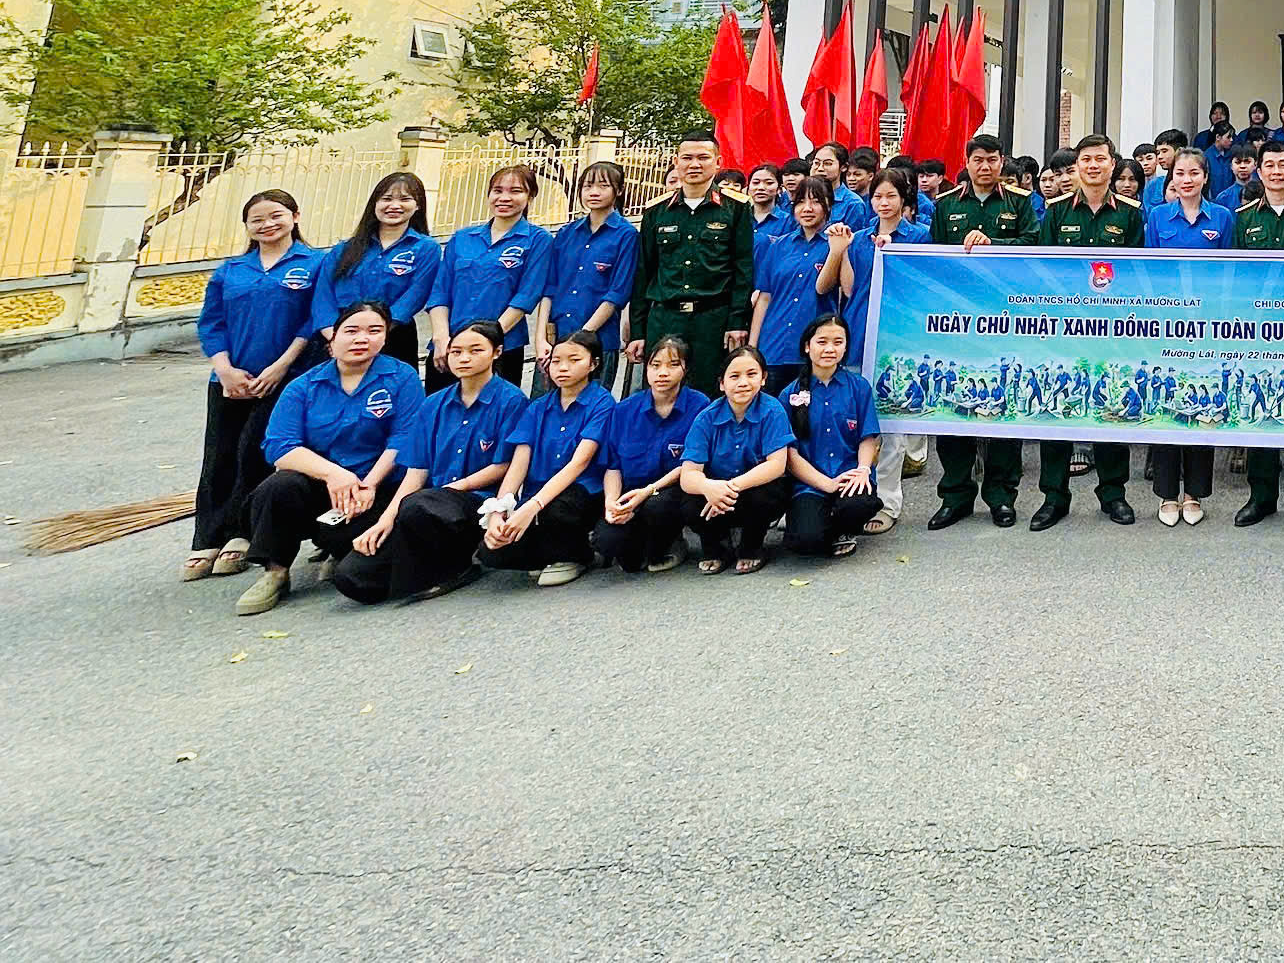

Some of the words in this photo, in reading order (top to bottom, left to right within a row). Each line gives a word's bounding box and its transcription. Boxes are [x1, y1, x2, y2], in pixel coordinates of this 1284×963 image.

[1008, 294, 1035, 305] ĐOÀN
[1039, 296, 1064, 305] TNCS
[1083, 295, 1100, 305] CHÍ
[1102, 297, 1127, 306] MINH
[1254, 300, 1271, 309] CHI
[927, 312, 972, 333] NGÀY
[976, 310, 1010, 334] CHỦ
[1014, 313, 1059, 339] NHẬT
[1063, 318, 1109, 337] XANH
[1113, 313, 1160, 338] ĐỒNG
[1165, 320, 1207, 343] LOẠT
[1212, 317, 1256, 340] TOÀN
[1161, 348, 1196, 360] Mường
[1220, 350, 1245, 361] ngày
[1247, 351, 1260, 360] 22
